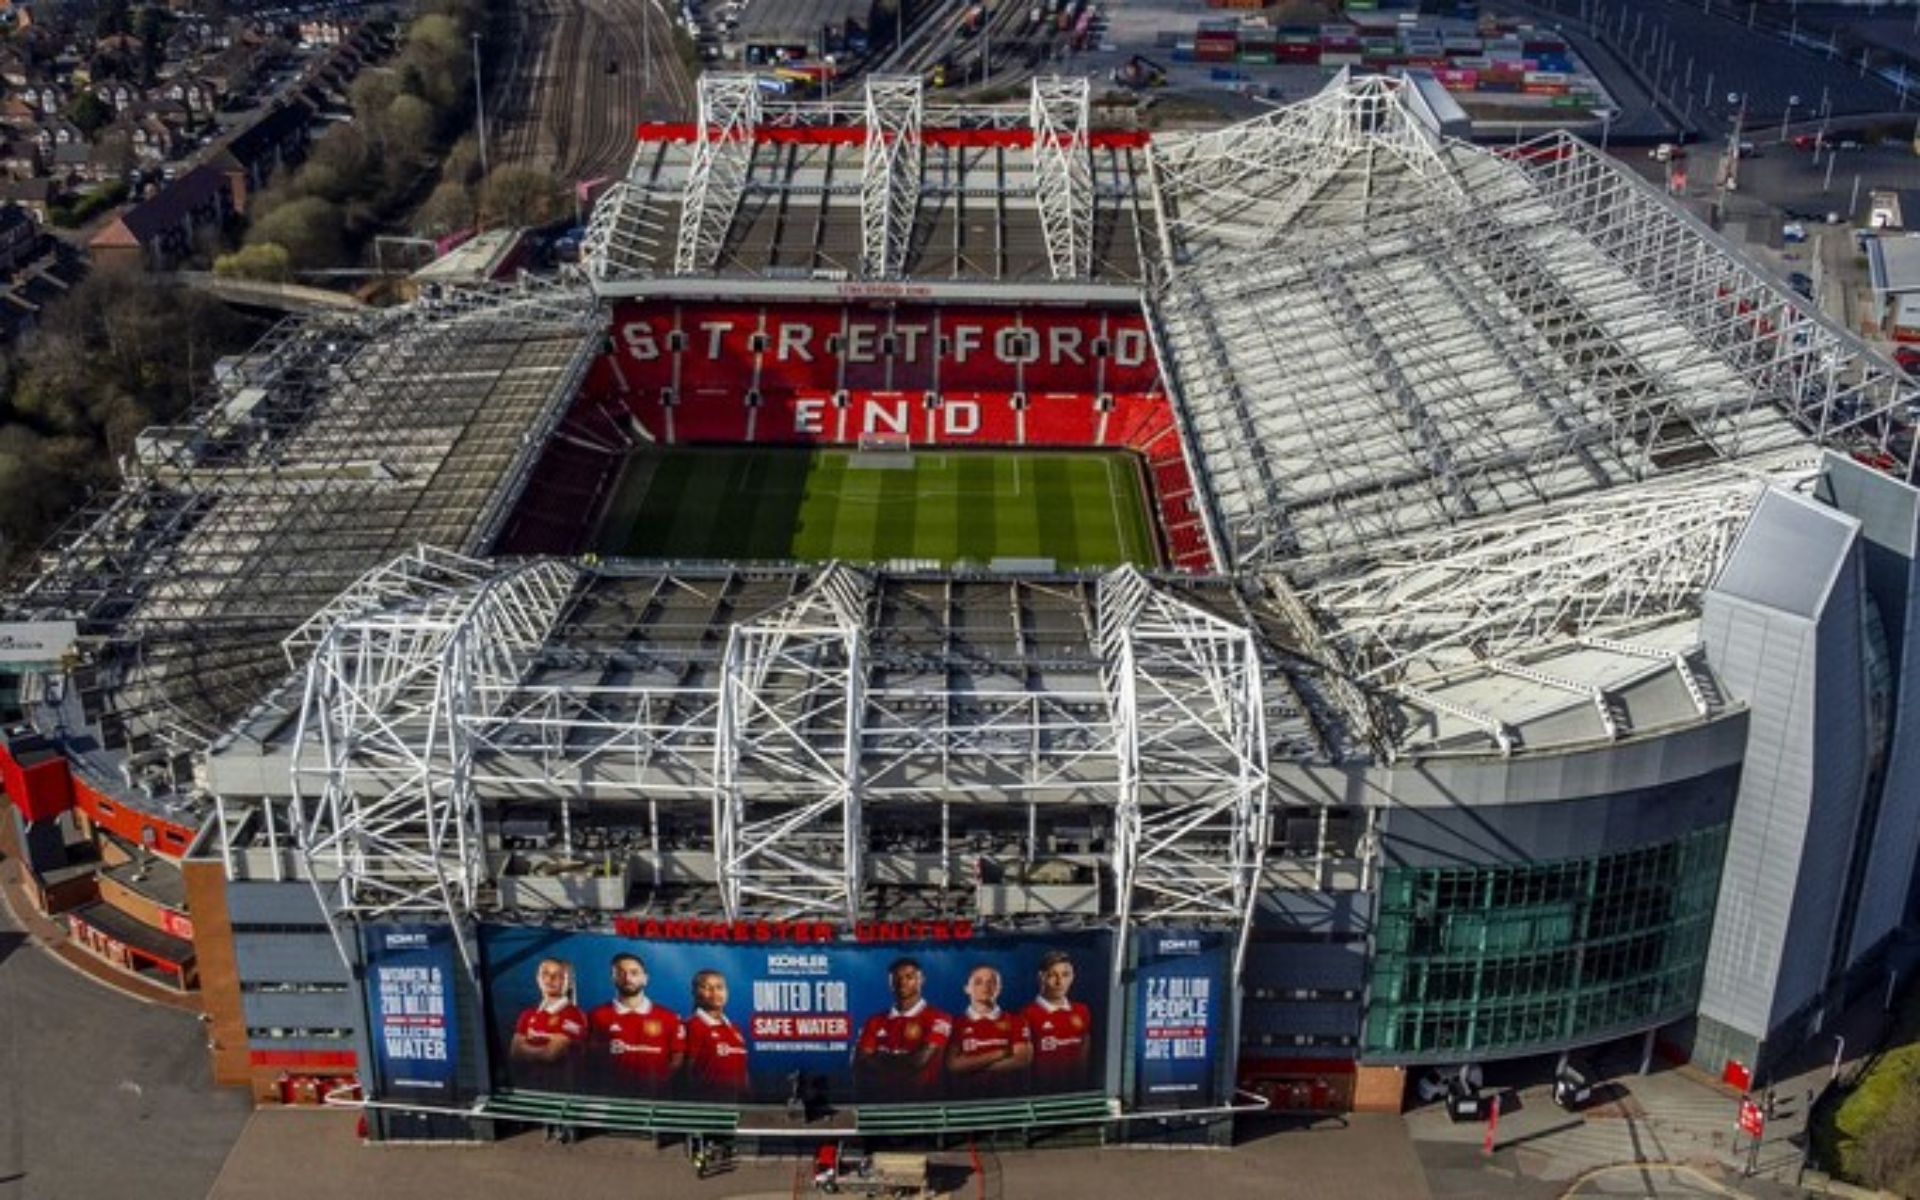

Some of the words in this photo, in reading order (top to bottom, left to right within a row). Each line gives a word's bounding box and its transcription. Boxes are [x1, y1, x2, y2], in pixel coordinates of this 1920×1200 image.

[622, 321, 1148, 367] STRETFORD
[794, 398, 980, 434] END
[615, 916, 833, 942] MANCHESTER
[854, 919, 974, 942] UNITED
[768, 954, 828, 967] KOHLER
[753, 981, 811, 1012] UNITED
[815, 981, 847, 1012] FOR
[1146, 998, 1209, 1019] PEOPLE
[755, 1018, 793, 1035] SAFE
[796, 1018, 848, 1035] WATER
[386, 1038, 447, 1061] WATER
